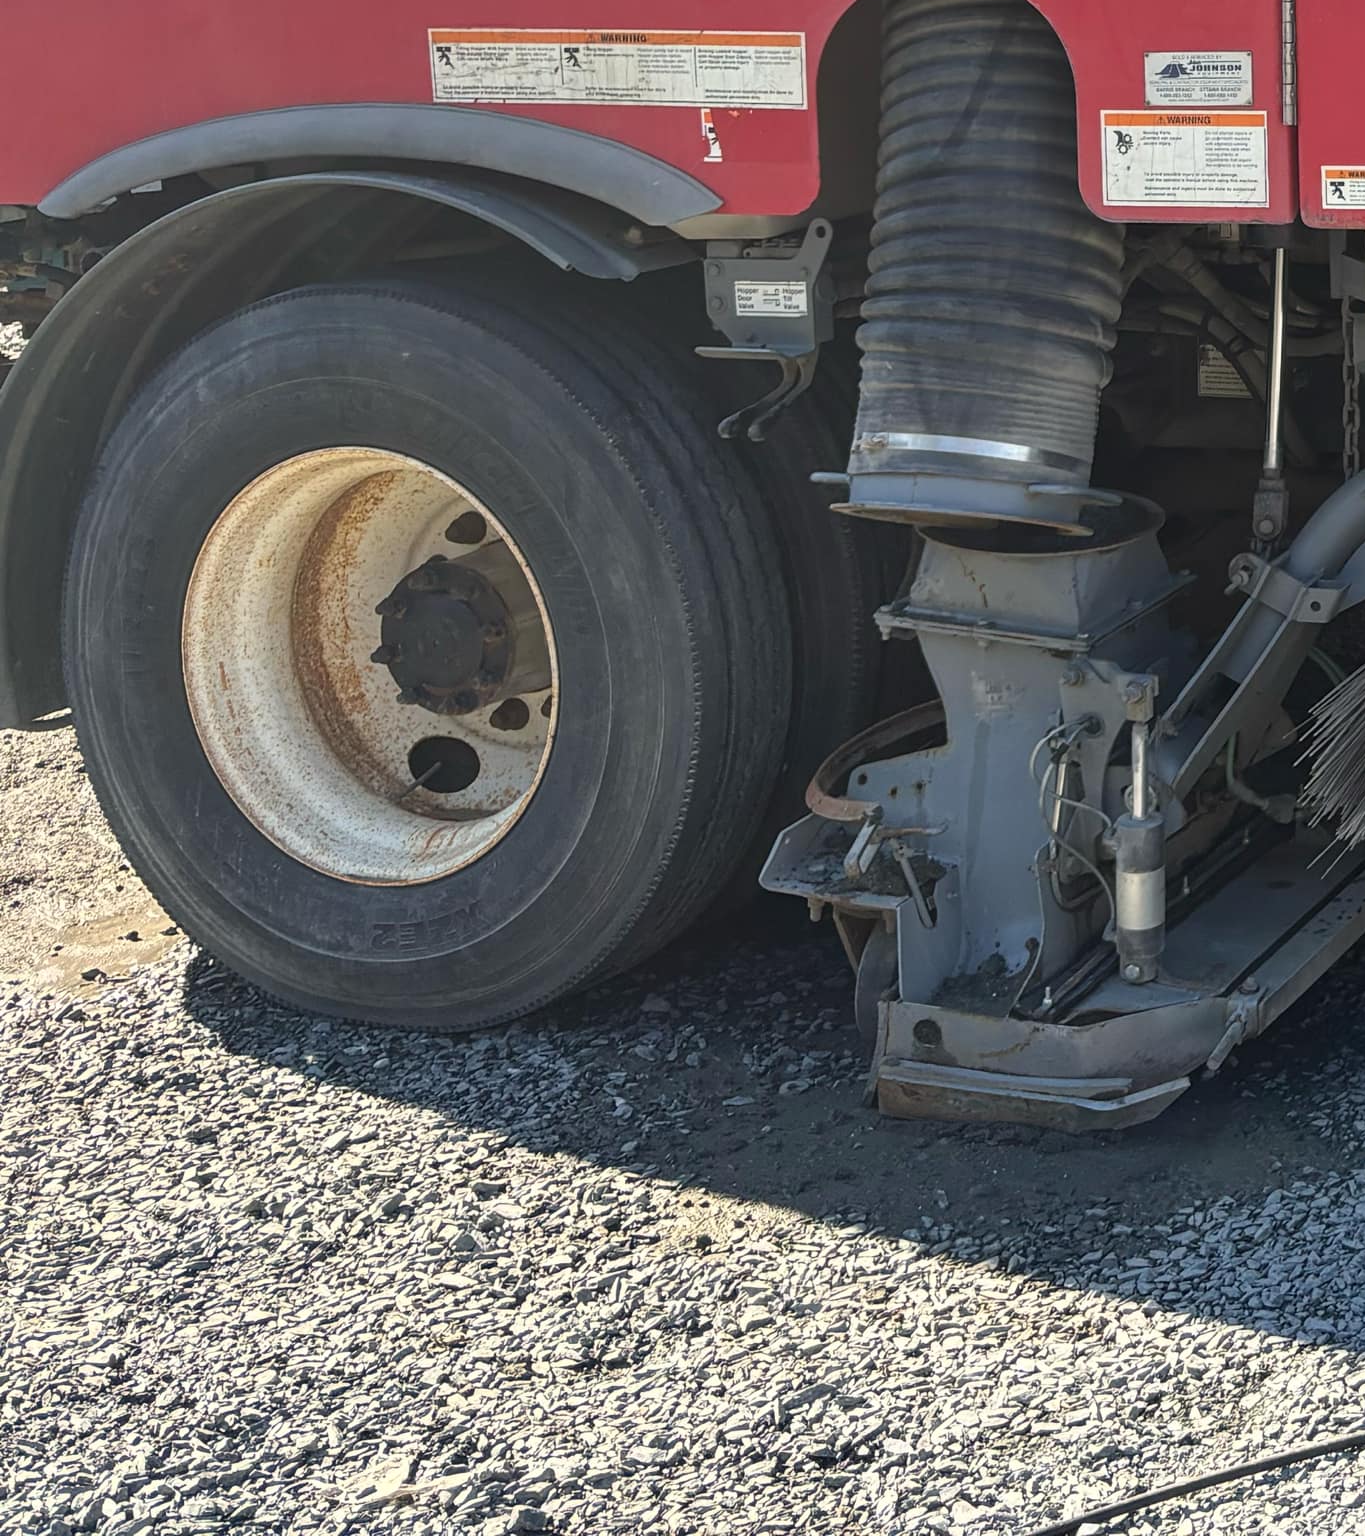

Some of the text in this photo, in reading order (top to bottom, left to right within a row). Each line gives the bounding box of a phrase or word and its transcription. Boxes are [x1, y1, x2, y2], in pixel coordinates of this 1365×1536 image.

[600, 33, 648, 43] WARNING
[1189, 64, 1242, 72] JOHNSON
[1167, 116, 1211, 124] WARNING
